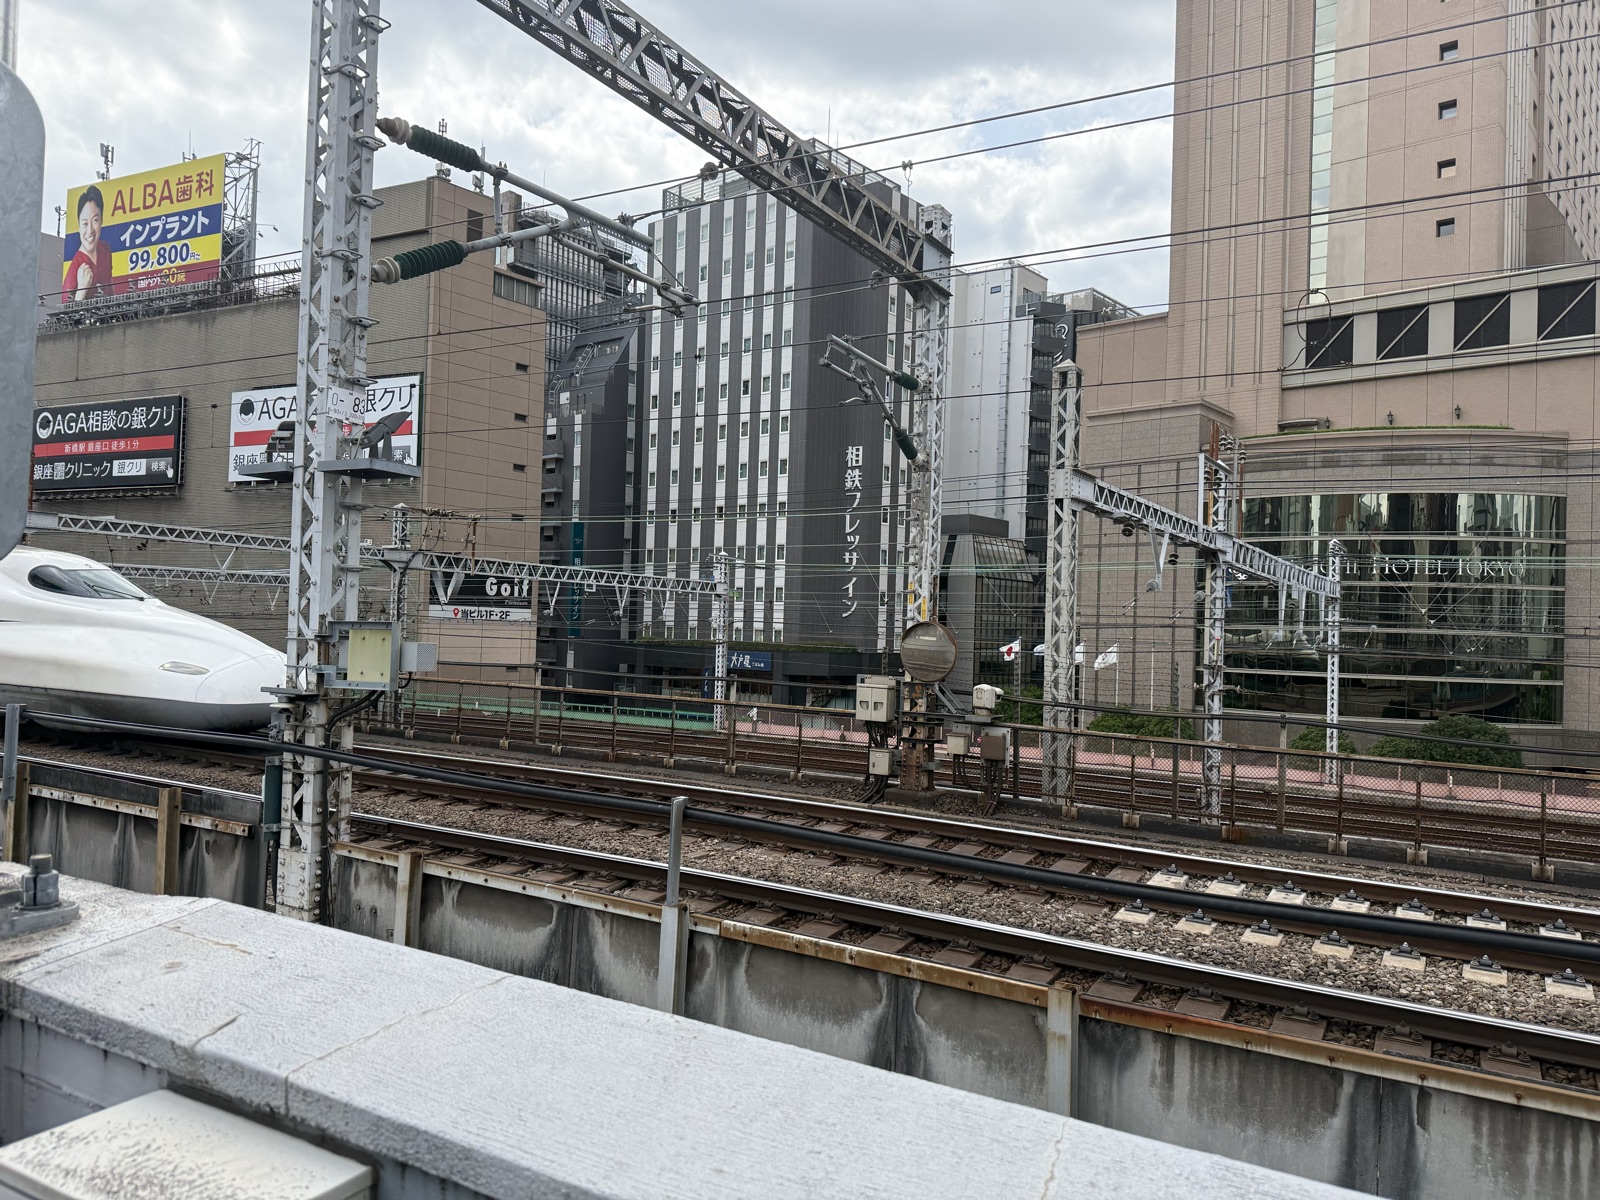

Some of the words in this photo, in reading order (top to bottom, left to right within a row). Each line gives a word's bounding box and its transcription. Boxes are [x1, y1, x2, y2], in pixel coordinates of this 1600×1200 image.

[111, 169, 214, 217] ALBA歯科
[120, 211, 210, 247] インプラント
[52, 404, 175, 435] AGA相談の銀クリ
[117, 461, 143, 474] 銀クリ
[842, 445, 863, 618] 相鉄フレッサイン
[1452, 557, 1524, 577] TOKYO
